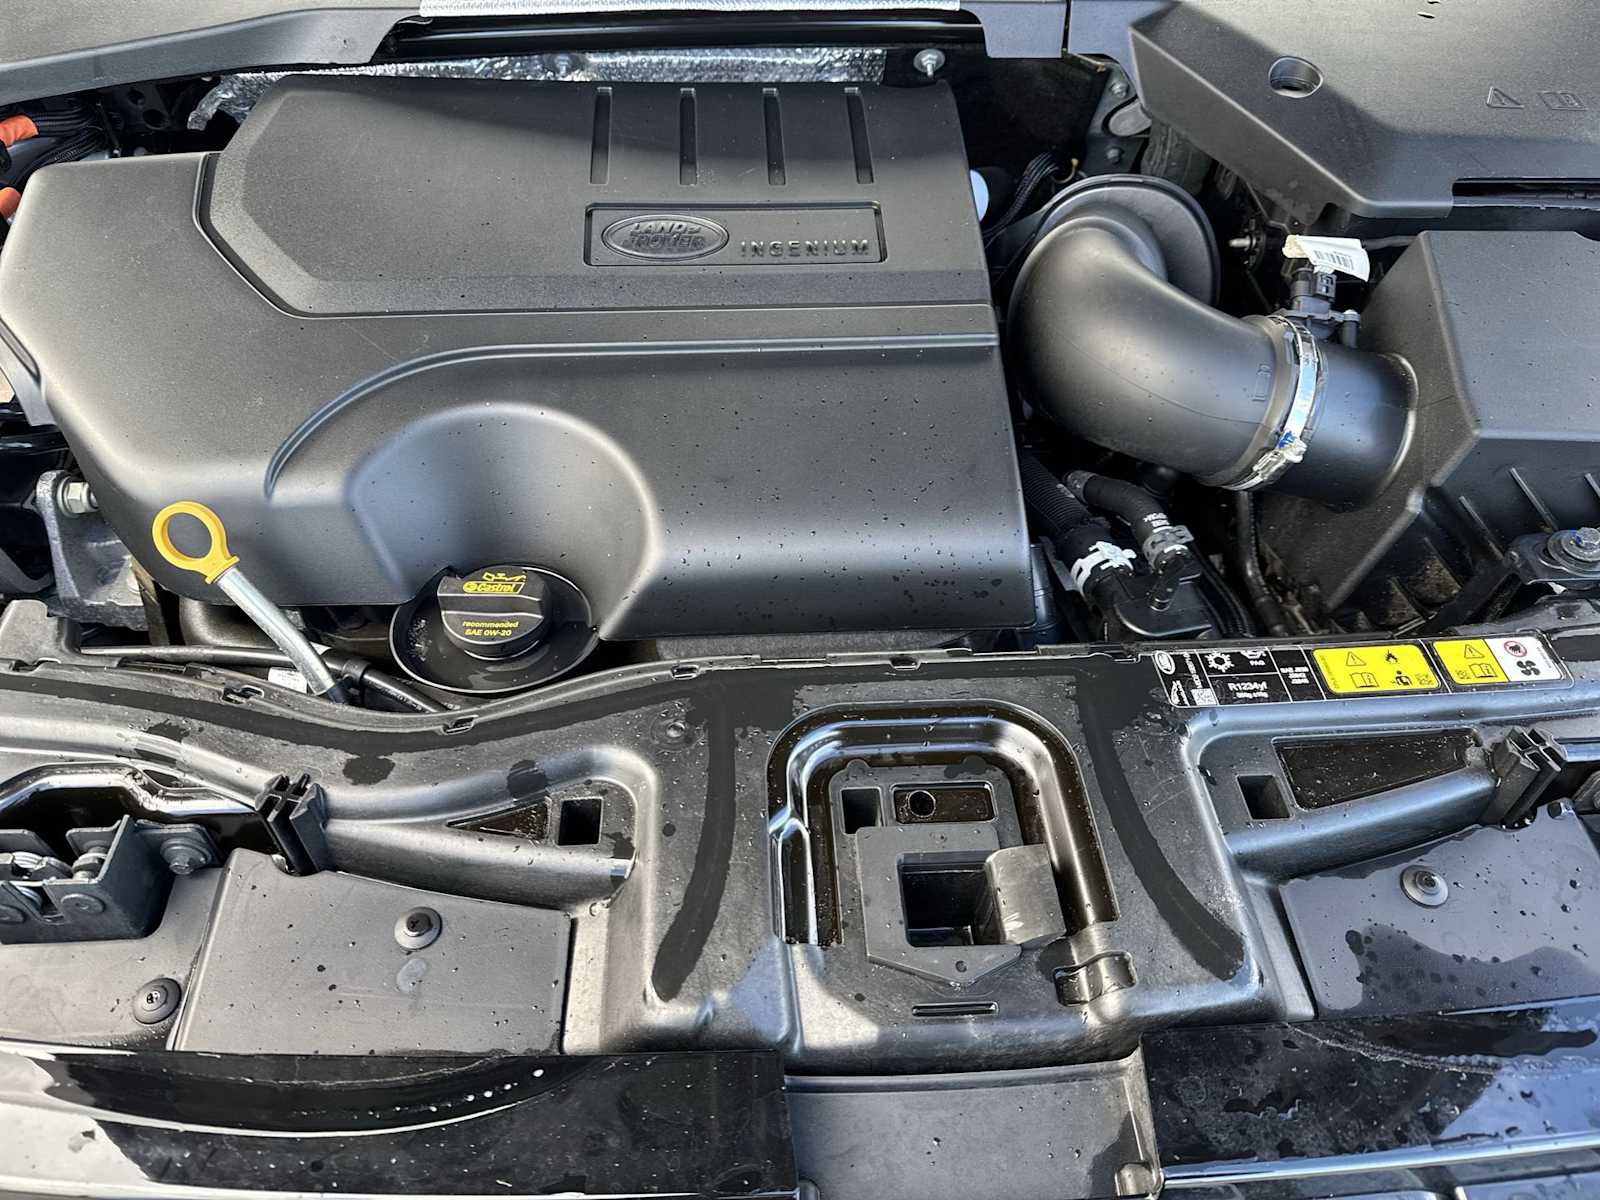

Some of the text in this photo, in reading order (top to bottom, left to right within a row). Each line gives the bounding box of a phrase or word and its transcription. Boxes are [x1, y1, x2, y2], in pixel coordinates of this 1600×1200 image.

[631, 222, 688, 236] LAND
[630, 234, 706, 249] ROVER
[740, 239, 870, 258] INGENIUM
[477, 583, 515, 592] Castrol
[464, 629, 483, 637] SAE
[1227, 681, 1268, 692] R1234yf
